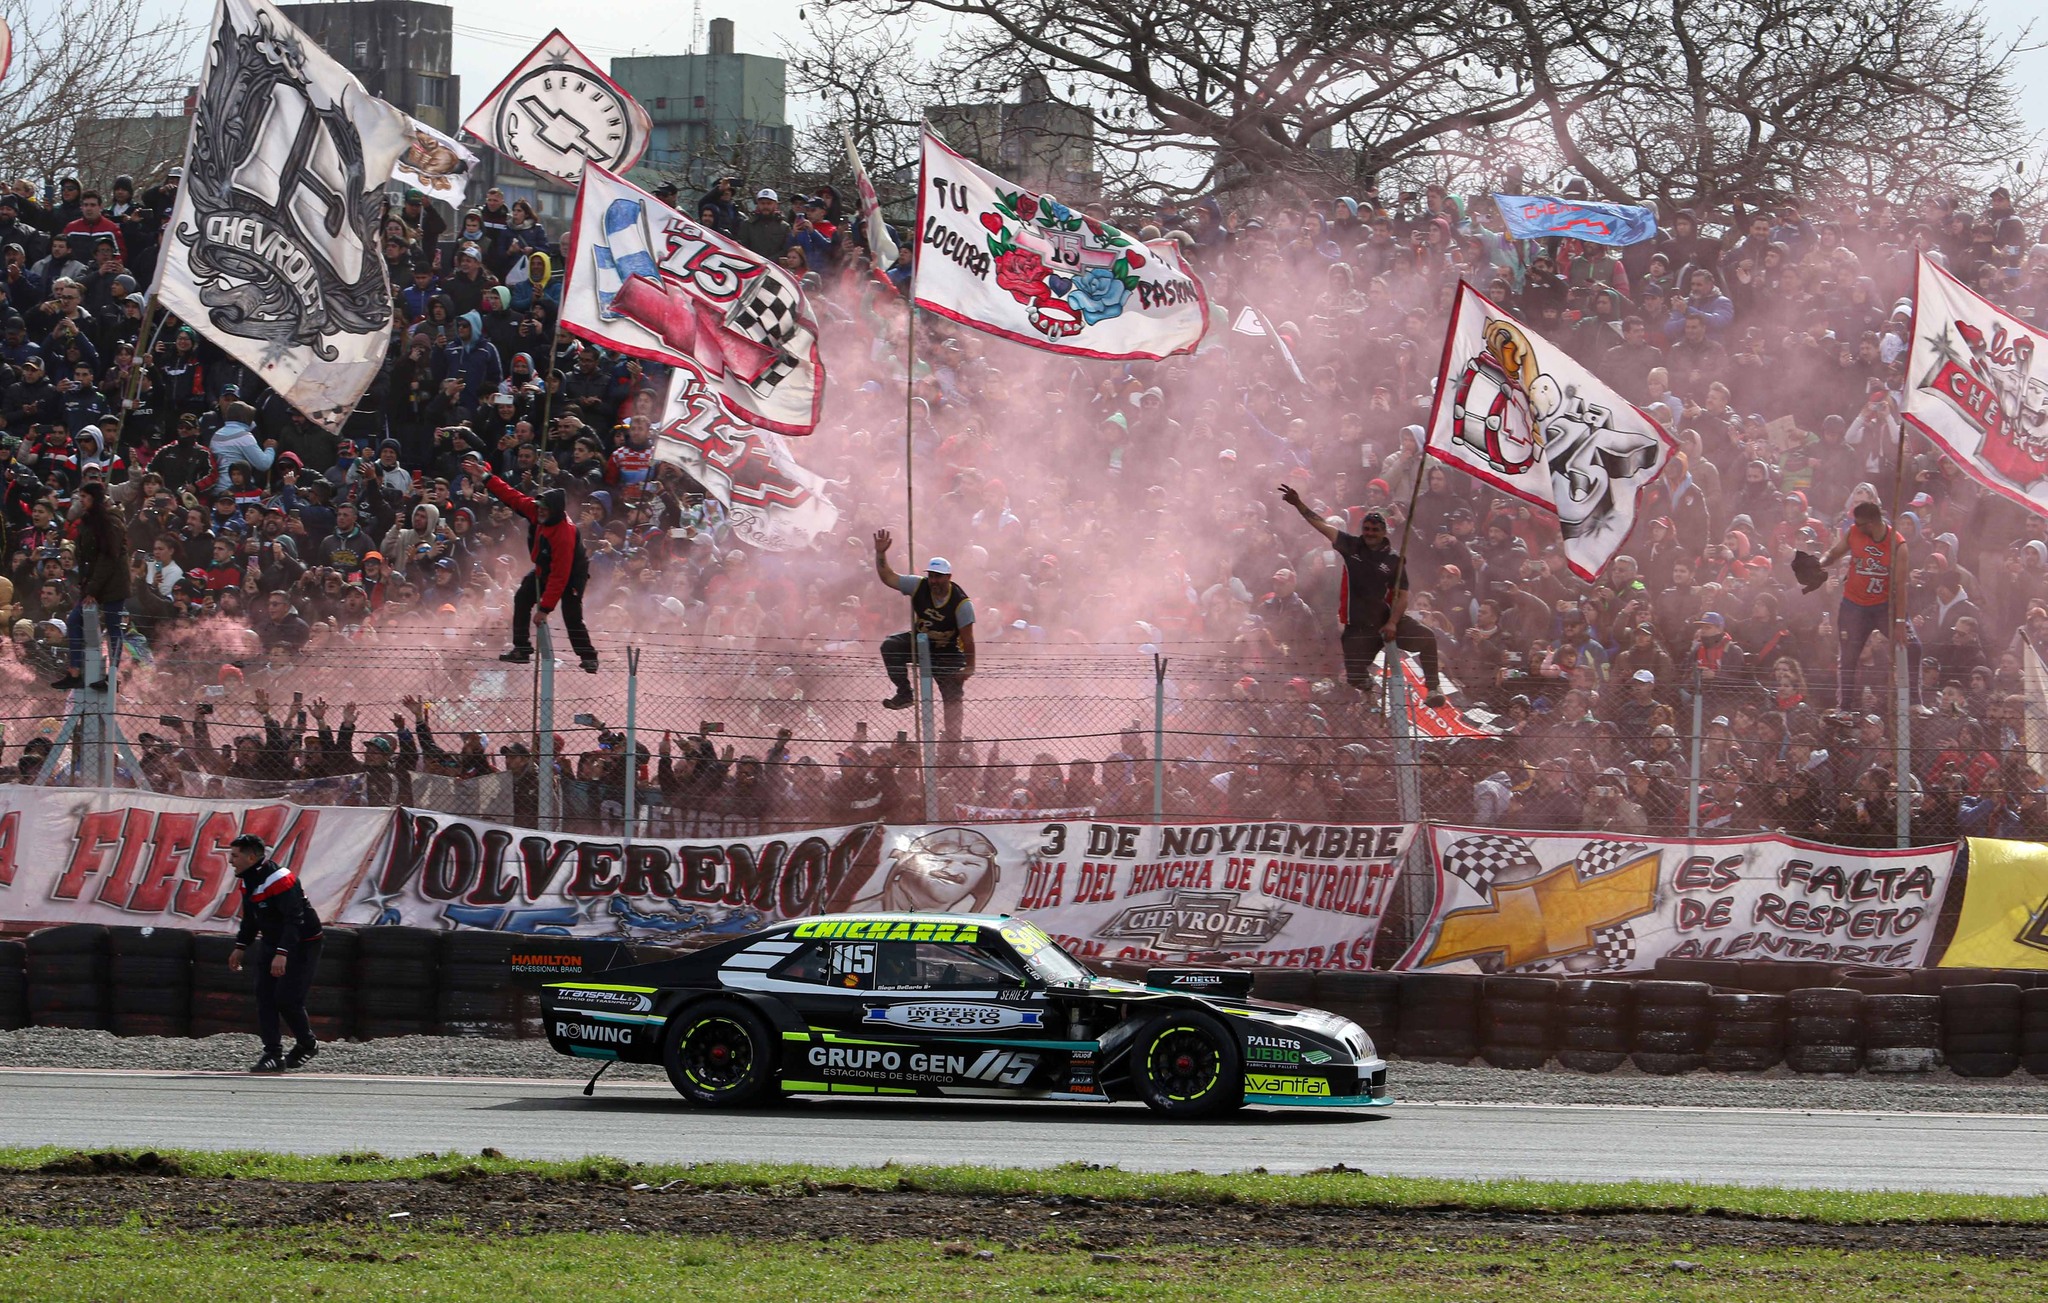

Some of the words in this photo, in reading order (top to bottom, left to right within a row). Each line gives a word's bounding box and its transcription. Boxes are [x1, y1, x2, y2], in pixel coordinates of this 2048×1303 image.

[543, 76, 621, 142] GENUINE
[932, 176, 969, 214] TU
[662, 218, 702, 238] La
[922, 215, 991, 281] LOCURA
[1050, 233, 1081, 266] 15
[206, 216, 324, 314] CHEVROLET
[658, 234, 753, 297] 15
[1137, 279, 1199, 310] PASION
[1040, 823, 1067, 857] 3
[1088, 823, 1141, 858] DE
[1159, 823, 1404, 859] NOVIEMBRE
[1018, 861, 1068, 910] DIA
[1074, 862, 1117, 902] DEL
[1125, 857, 1213, 896] HINCHA
[1226, 857, 1256, 891] DE
[1262, 859, 1395, 916] CHEVROLET
[1675, 855, 1744, 893] ES
[1780, 858, 1935, 902] FALTA
[1129, 908, 1268, 936] CHEVROLET
[1676, 897, 1735, 932] DE
[1754, 892, 1925, 938] RESPETO
[793, 921, 979, 943] CHICHARRA
[1666, 931, 1918, 964] ALENTARTE
[511, 954, 583, 966] HAMILTON
[832, 944, 875, 975] 115
[1000, 990, 1021, 1000] SERIE
[1021, 990, 1029, 1000] 2
[907, 1010, 1000, 1019] IMPERIO
[907, 1016, 1000, 1025] 2000
[556, 1021, 632, 1044] ROWING
[1248, 1035, 1301, 1050] PALLETS
[808, 1046, 901, 1071] GRUPO
[909, 1053, 965, 1075] GEN
[963, 1049, 1041, 1085] 115
[1247, 1046, 1300, 1063] LIEBIG
[822, 1068, 887, 1079] ESTACIONES
[889, 1071, 903, 1080] DE
[906, 1073, 954, 1083] SERVICIO
[1071, 1085, 1094, 1093] FRAM
[1244, 1075, 1327, 1094] Avantfar
